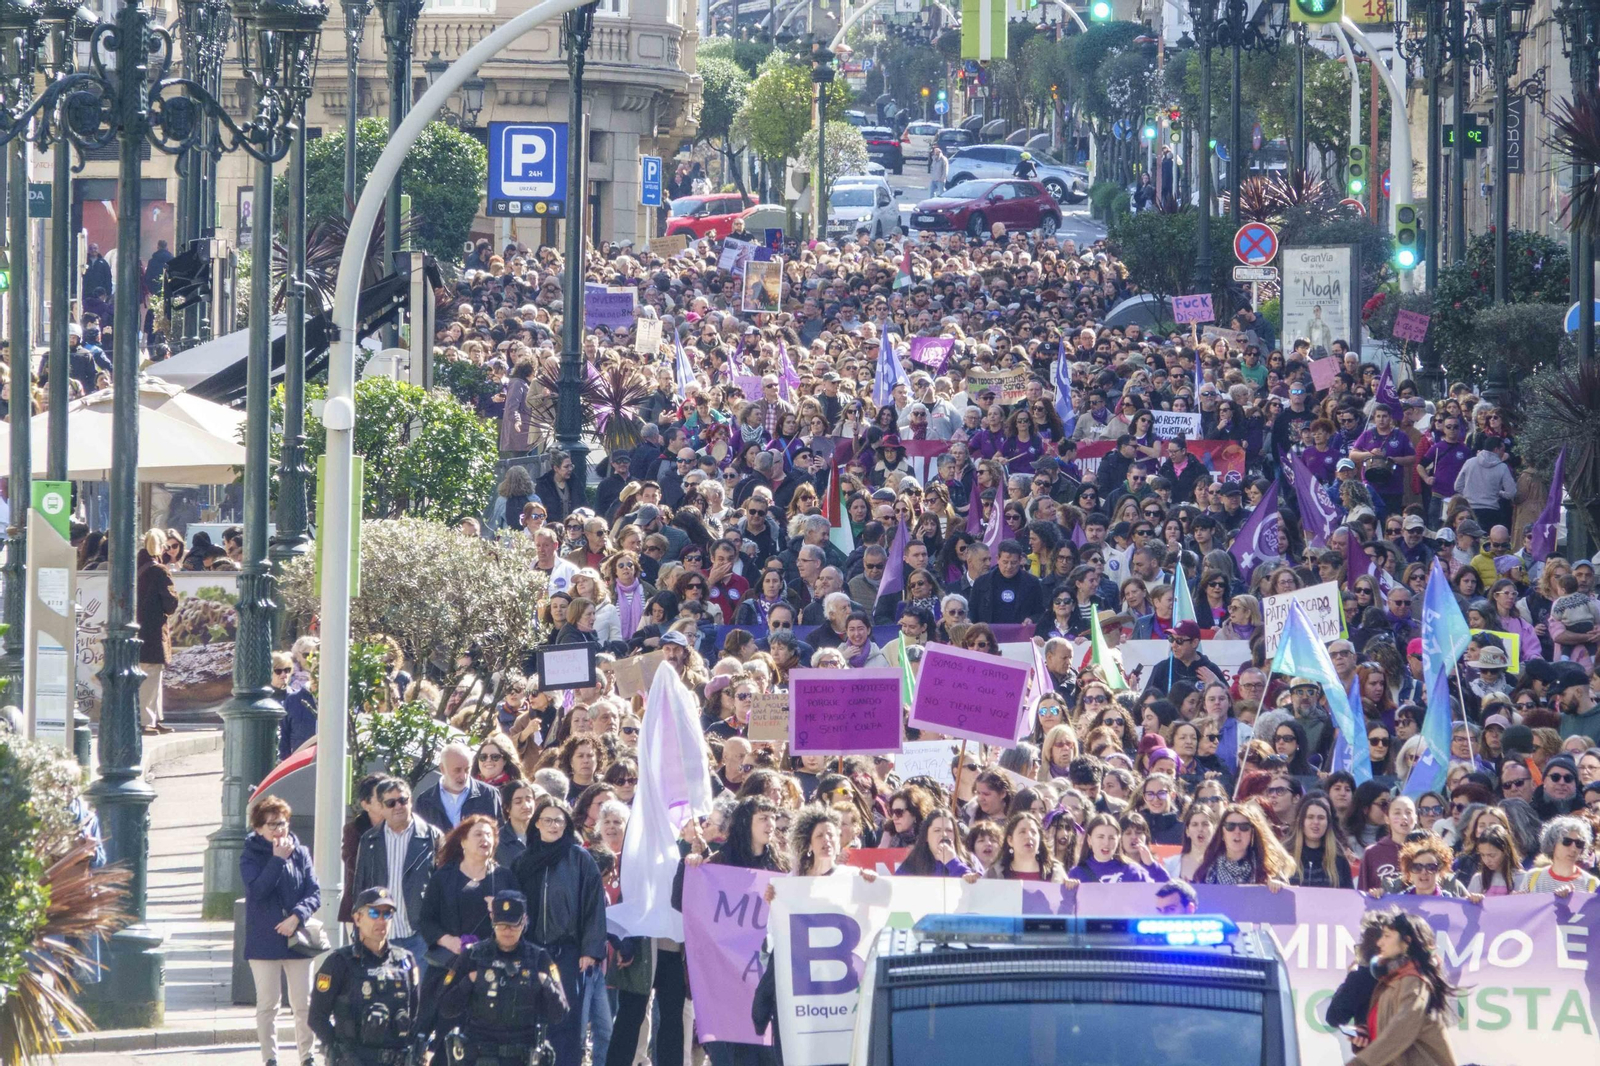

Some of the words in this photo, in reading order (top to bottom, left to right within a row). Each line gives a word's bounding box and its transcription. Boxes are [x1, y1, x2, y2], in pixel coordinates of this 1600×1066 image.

[864, 60, 871, 70] P
[511, 134, 547, 177] P
[648, 161, 657, 181] P
[1303, 275, 1341, 300] Moda
[931, 657, 963, 670] SOMOS
[982, 669, 1009, 681] GRITO
[803, 686, 834, 694] LUCHO
[851, 684, 897, 693] PROTESTO
[934, 678, 944, 686] DE
[952, 682, 968, 690] LAS
[978, 686, 996, 695] QUE
[1005, 691, 1015, 699] YA
[807, 699, 838, 707] PORQUE
[848, 698, 882, 706] CUANDO
[924, 696, 939, 706] NO
[949, 701, 982, 713] TIENEN
[989, 707, 1010, 719] VOZ
[804, 713, 816, 722] ME
[854, 723, 882, 731] CULPA
[795, 1004, 848, 1019] Bloque
